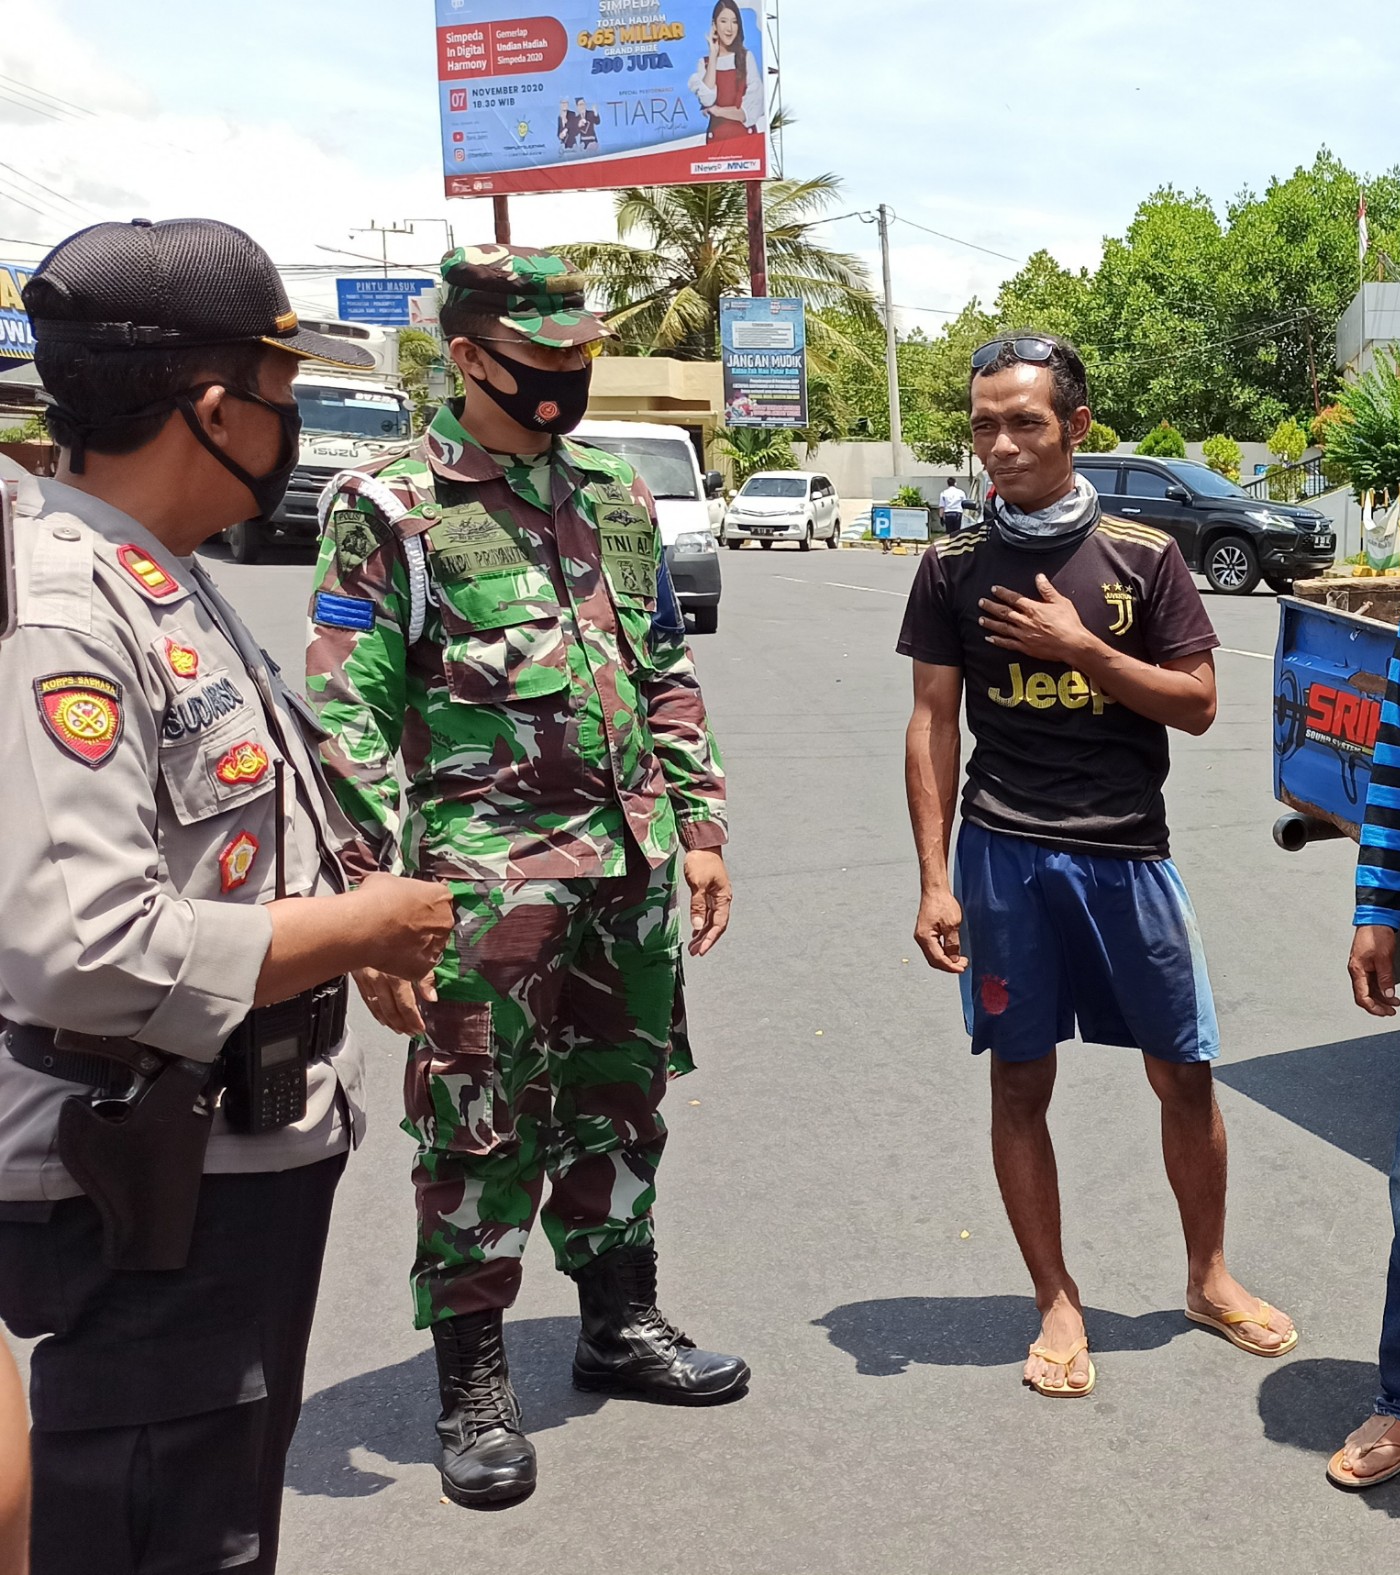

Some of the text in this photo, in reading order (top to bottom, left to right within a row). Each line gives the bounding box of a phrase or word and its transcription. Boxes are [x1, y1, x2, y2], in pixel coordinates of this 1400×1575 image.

[599, 0, 661, 13] SIMPEDA
[597, 14, 666, 27] TOTAL HADIAH
[446, 30, 484, 44] Simpeda
[496, 28, 528, 39] Gemerlap
[577, 22, 685, 50] 6,65 MILIAR
[447, 44, 485, 58] In Digital
[497, 38, 548, 51] Undian Hadiah
[604, 44, 658, 56] GRAND PRIZE
[447, 59, 487, 71] Harmony
[497, 52, 543, 65] Simpeda 2020
[591, 53, 673, 74] 500 JUTA
[472, 83, 544, 97] NOVEMBER 2020
[451, 92, 465, 107] 07
[472, 98, 515, 108] 18.30 WIB
[606, 97, 689, 127] TIARA
[356, 282, 415, 291] PINTU MASUK
[727, 354, 803, 368] JANGAN MUDIK
[313, 447, 359, 458] ISUZU
[875, 517, 890, 535] P
[602, 534, 651, 555] TNI AL
[42, 676, 74, 691] KORPS
[1305, 729, 1332, 743] SOUND
